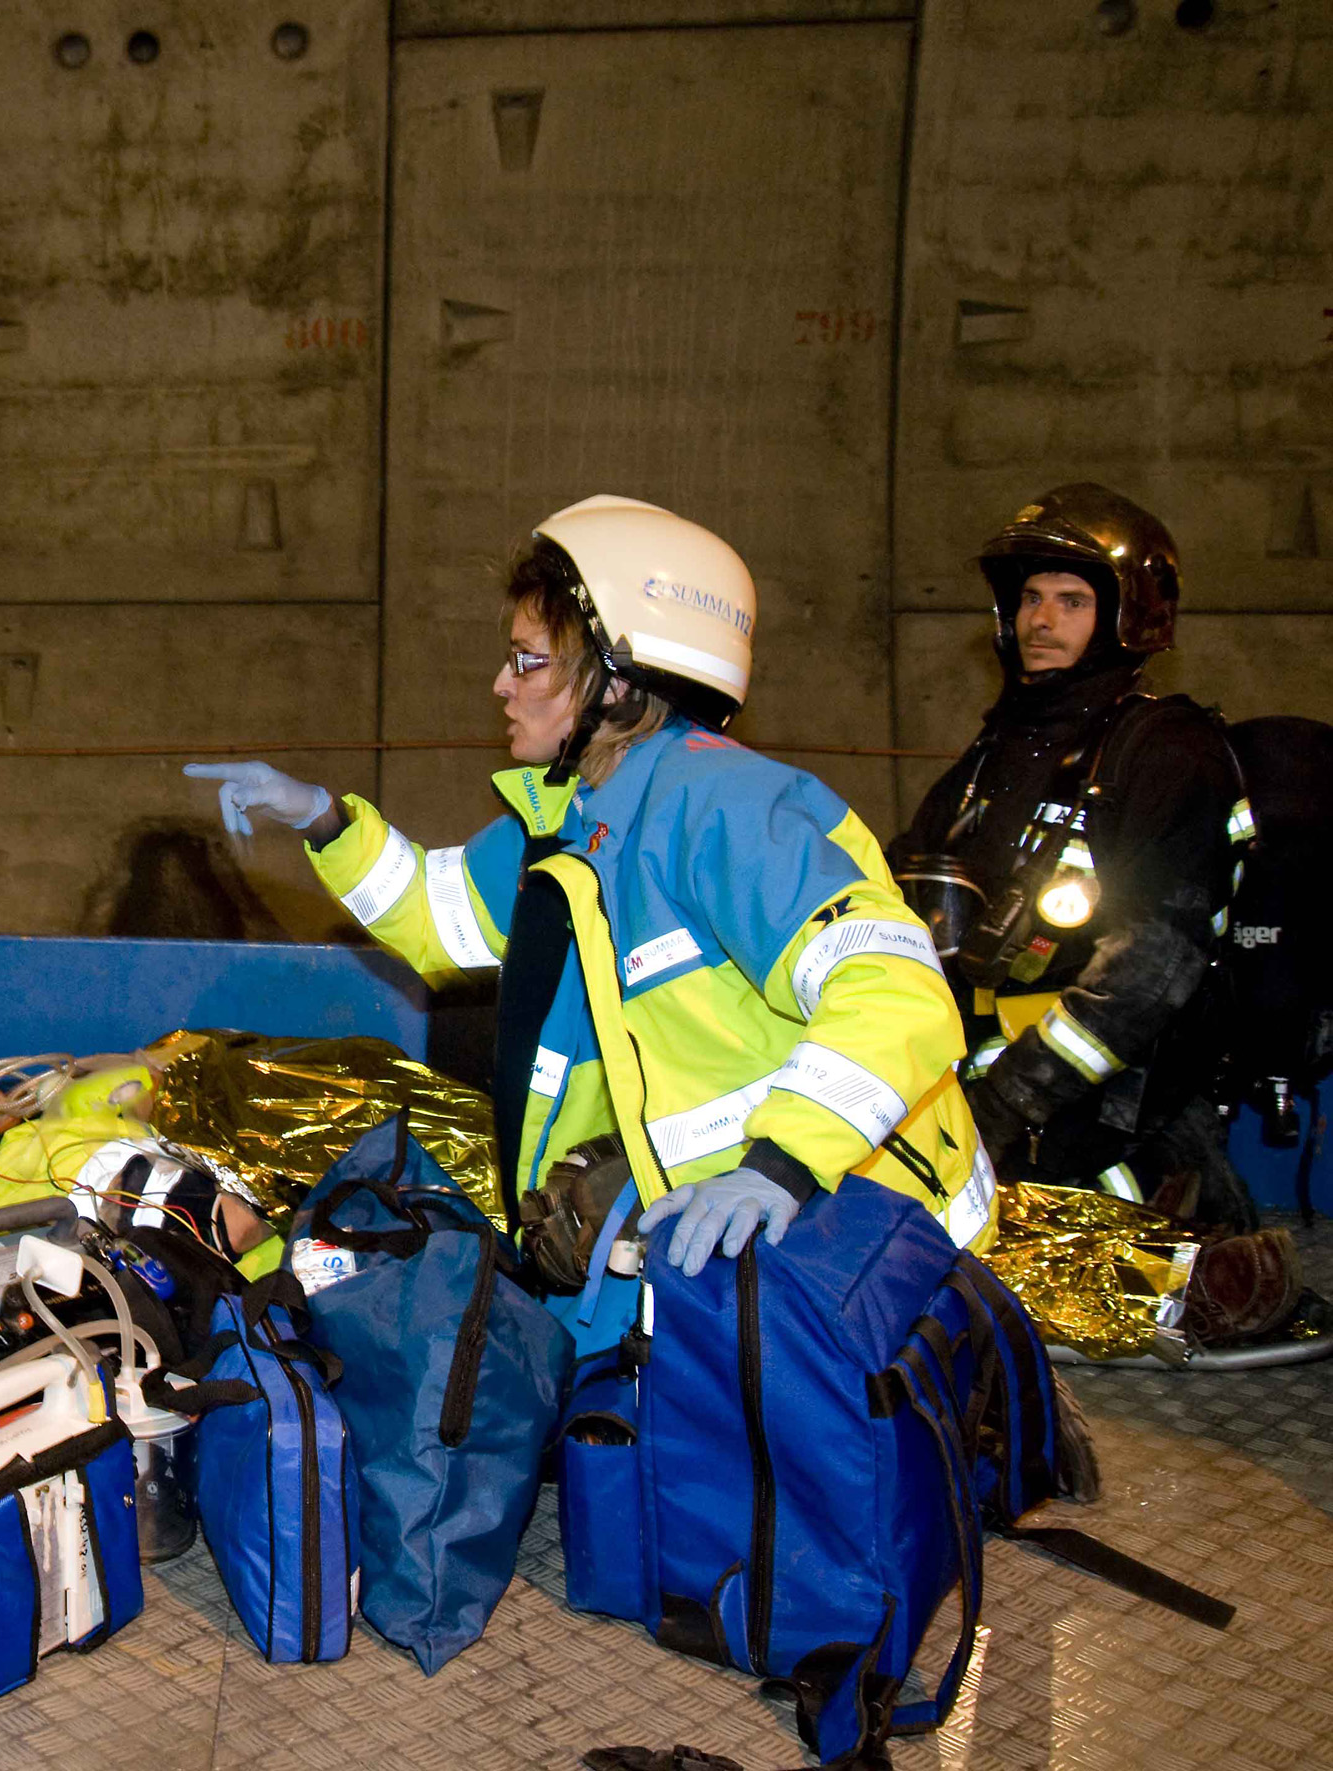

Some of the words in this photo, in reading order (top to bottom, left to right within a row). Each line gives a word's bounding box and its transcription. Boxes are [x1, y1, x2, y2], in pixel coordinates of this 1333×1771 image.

[670, 582, 731, 620] SUMMA
[734, 609, 752, 637] 112
[521, 771, 542, 813] SUMMA
[534, 814, 547, 832] 112
[643, 935, 685, 960] SUMMA
[878, 931, 928, 952] SUMMA
[804, 1063, 828, 1081] 112
[691, 1114, 740, 1138] SUMMA
